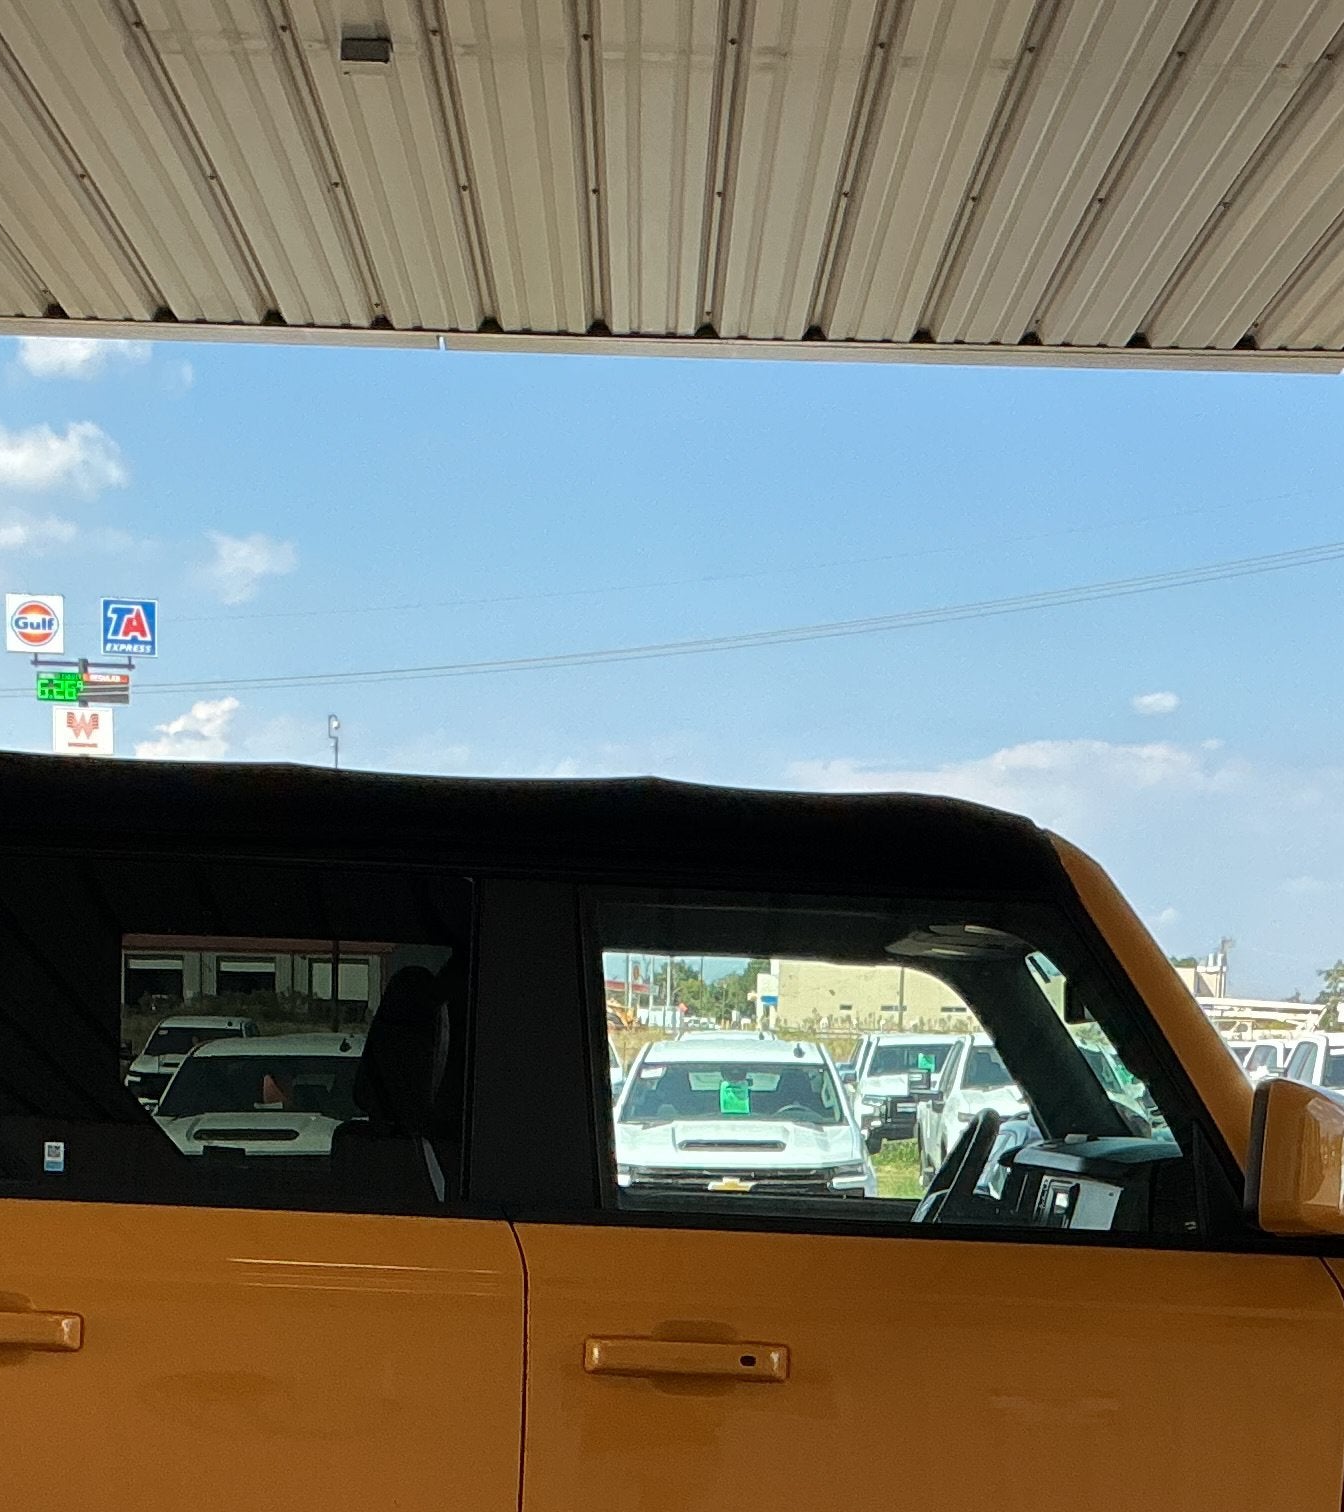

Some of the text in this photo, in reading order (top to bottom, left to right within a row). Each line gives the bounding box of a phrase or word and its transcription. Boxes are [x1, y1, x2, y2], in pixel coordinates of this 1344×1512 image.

[14, 616, 55, 631] Gulf
[107, 604, 151, 640] TA
[105, 643, 152, 653] EXPRESS
